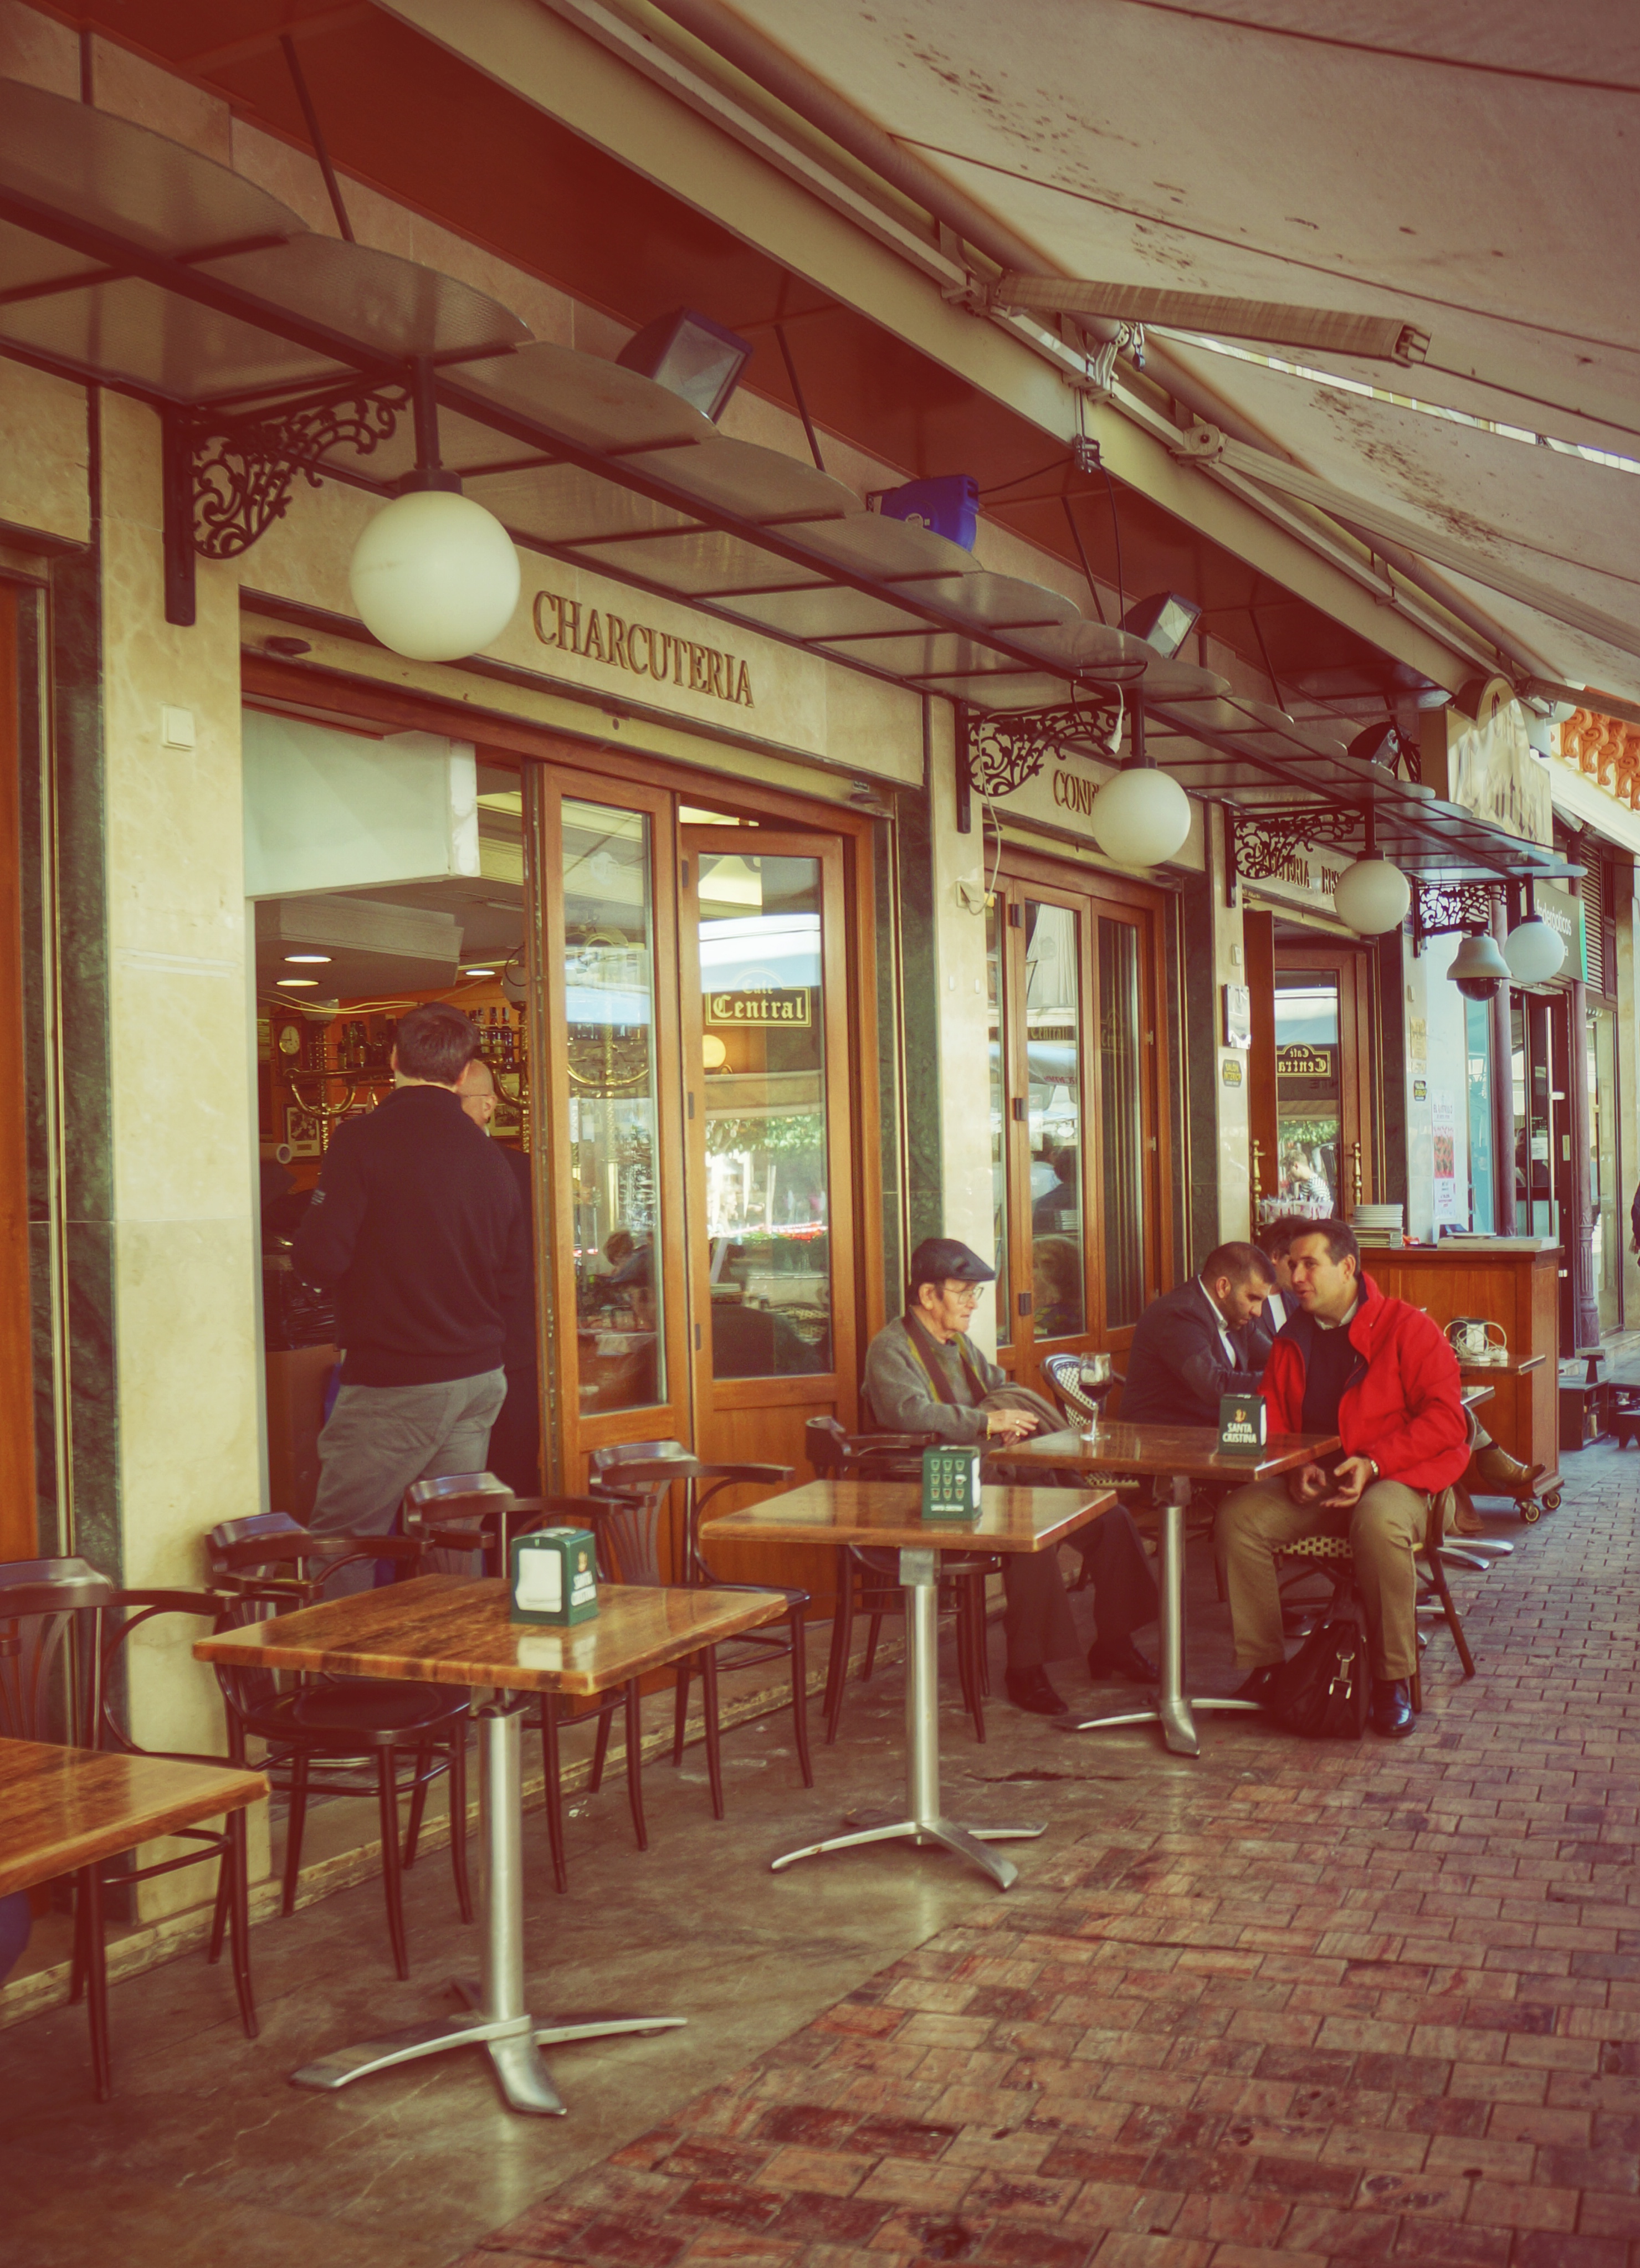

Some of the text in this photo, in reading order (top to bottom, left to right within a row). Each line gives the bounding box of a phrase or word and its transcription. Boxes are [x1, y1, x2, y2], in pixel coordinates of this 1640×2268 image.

[532, 590, 755, 709] CHARCUTERIA
[713, 994, 804, 1019] Central
[1228, 1423, 1252, 1433] SANTA
[1222, 1433, 1257, 1443] CRISTINA
